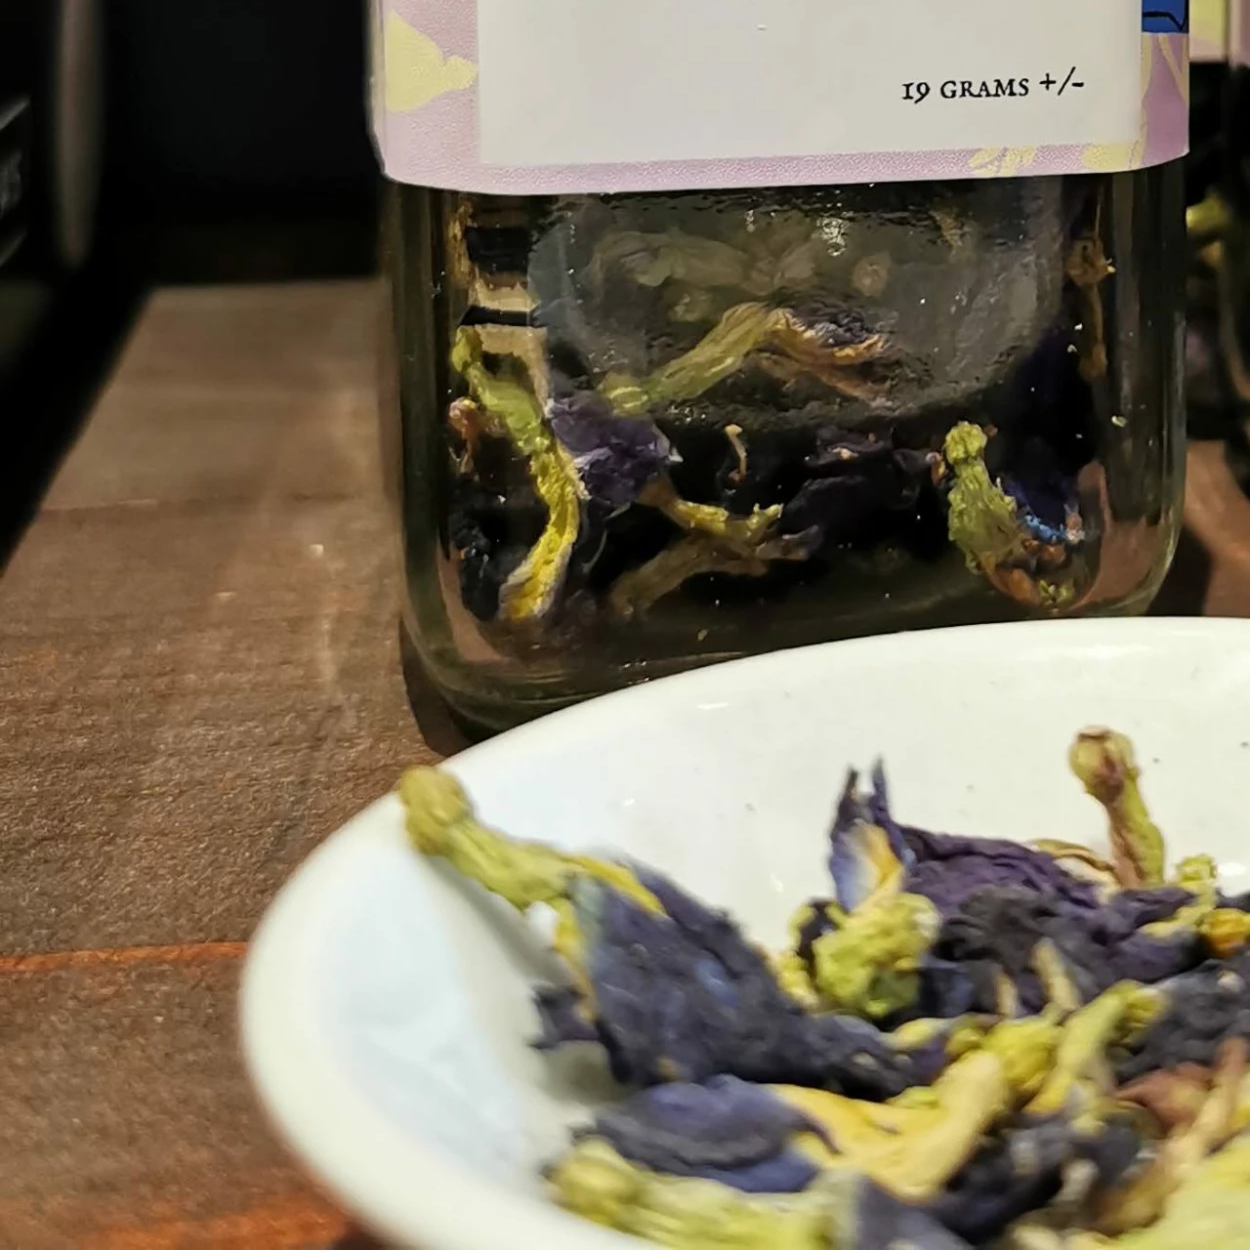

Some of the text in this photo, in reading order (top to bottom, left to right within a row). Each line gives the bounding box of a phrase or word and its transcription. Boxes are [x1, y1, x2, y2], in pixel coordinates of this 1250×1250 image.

[903, 67, 1084, 104] 19 GRAMS +/-
